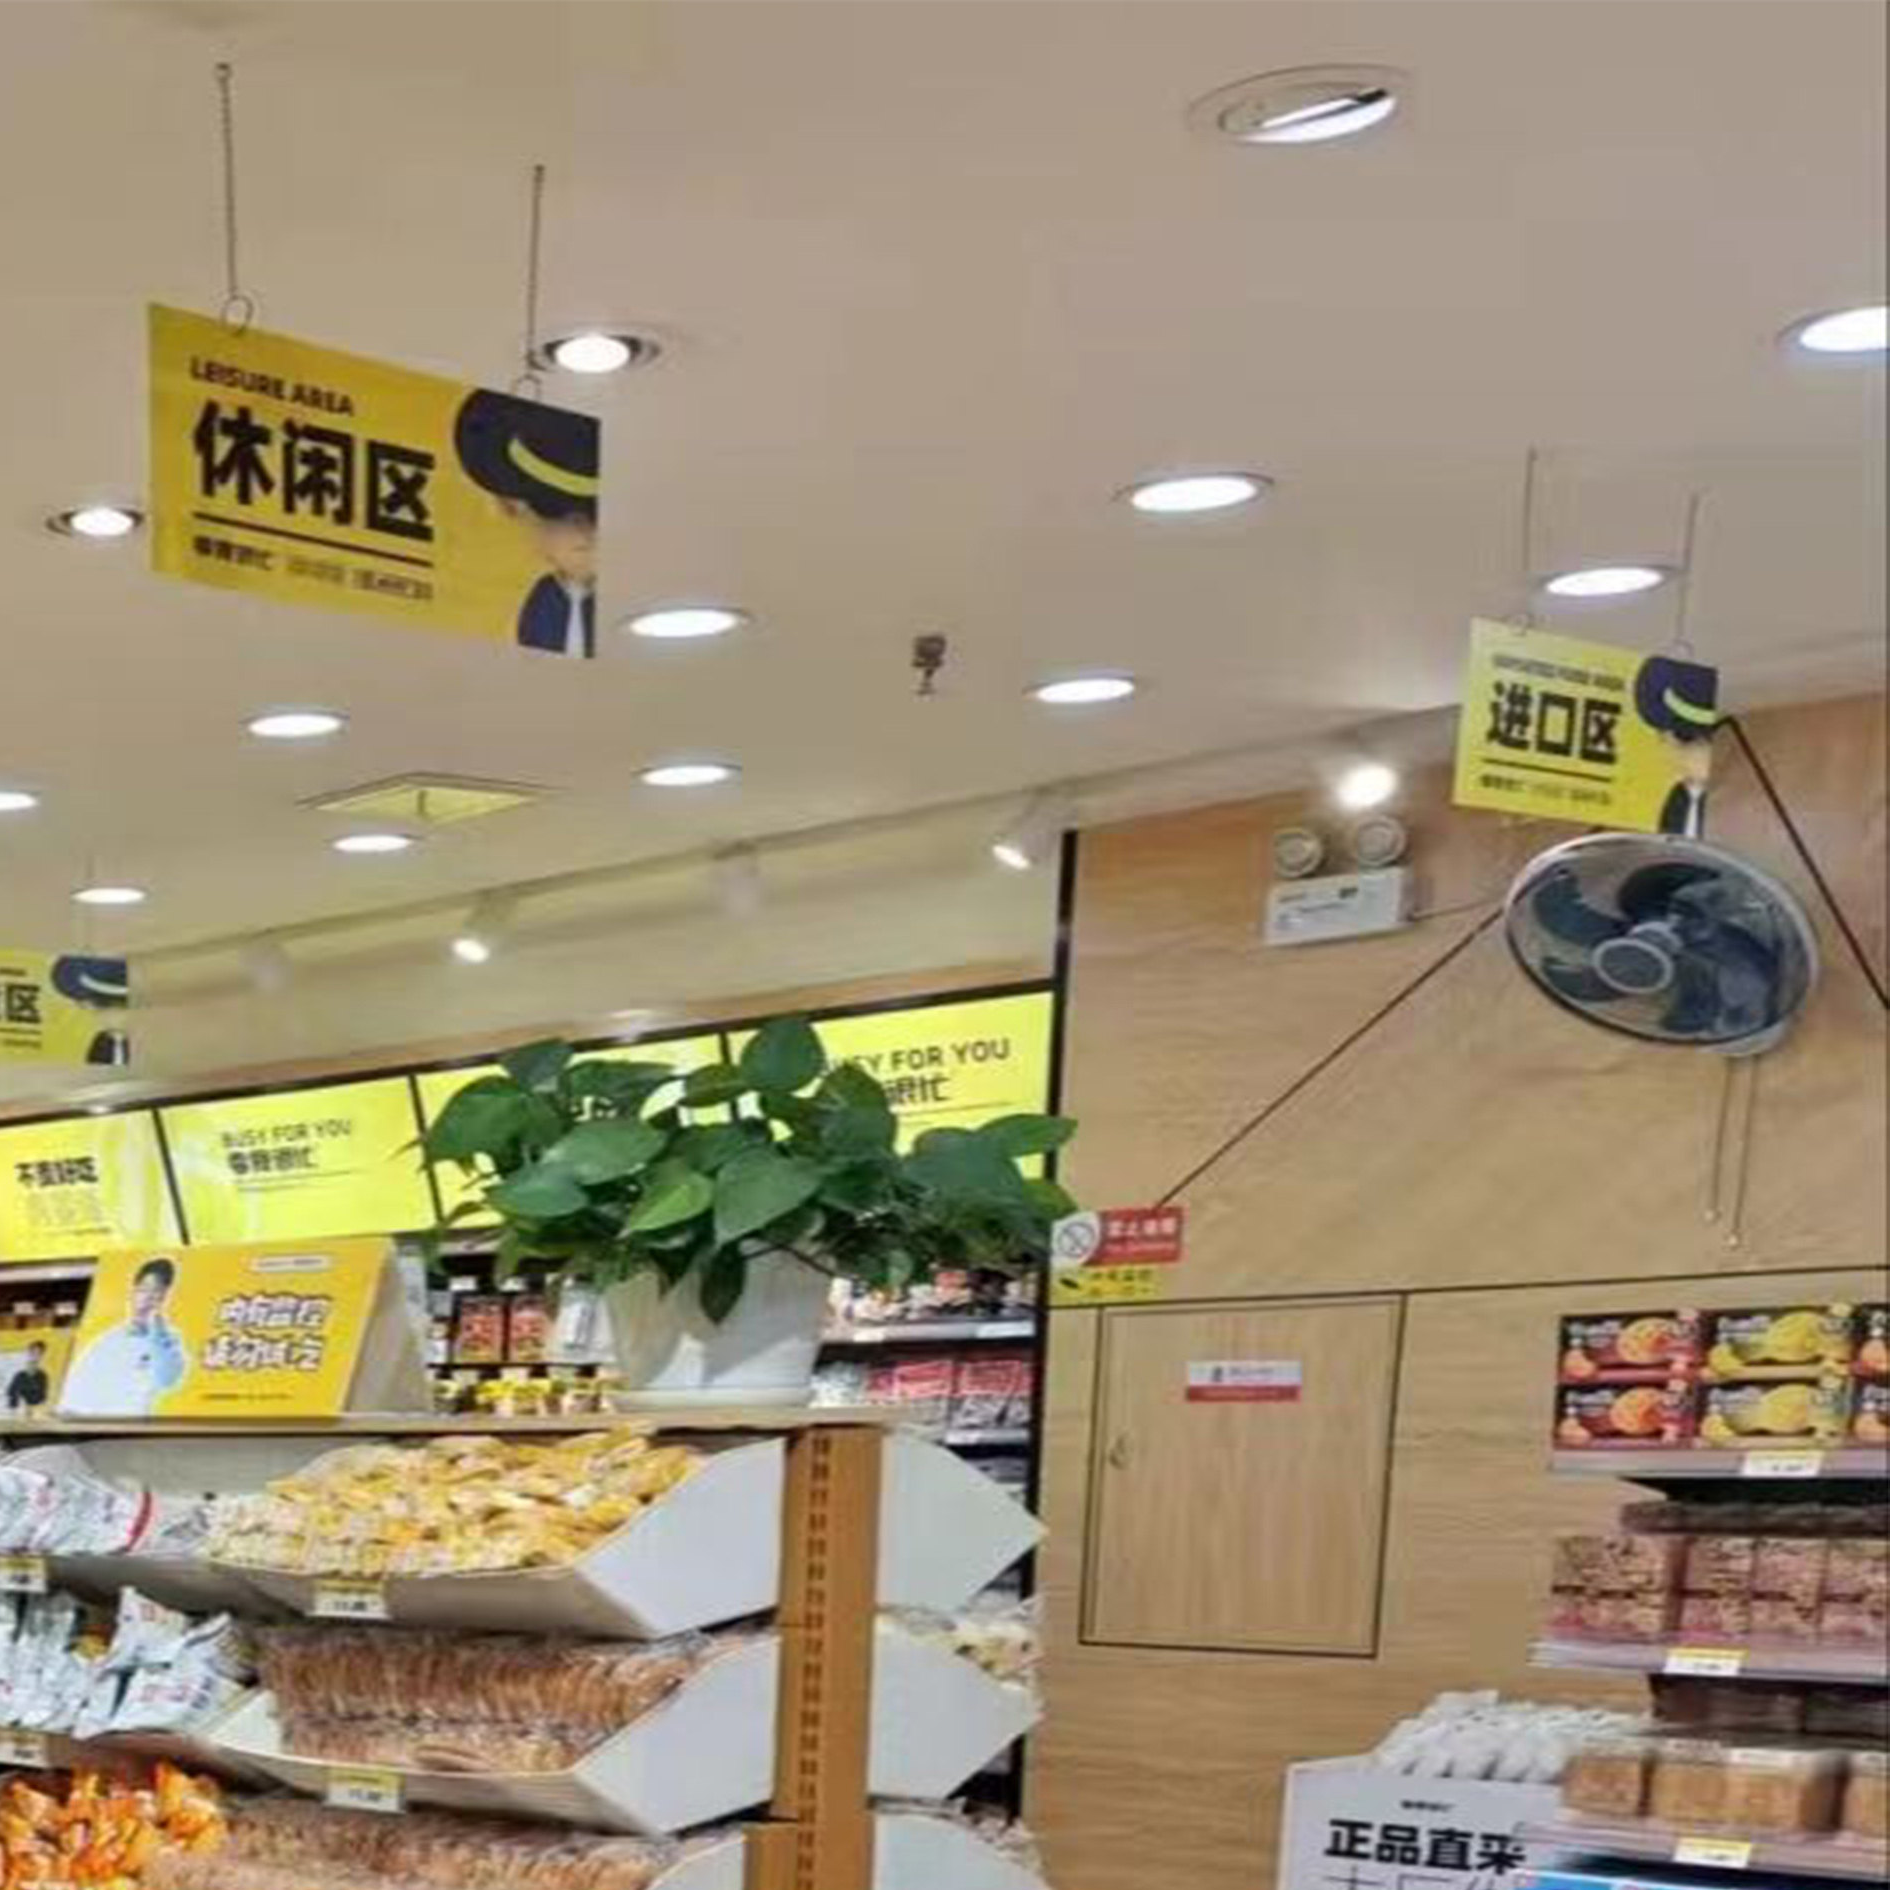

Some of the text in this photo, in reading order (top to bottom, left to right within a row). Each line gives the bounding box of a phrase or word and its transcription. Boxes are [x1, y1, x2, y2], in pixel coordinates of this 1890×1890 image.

[190, 355, 355, 417] LEISURE AREA
[193, 398, 436, 543] 休闲区
[1486, 680, 1623, 766] 进口区
[891, 1046, 944, 1071] FOR
[951, 1038, 1010, 1065] YOU
[1324, 1818, 1526, 1875] 正品直采
